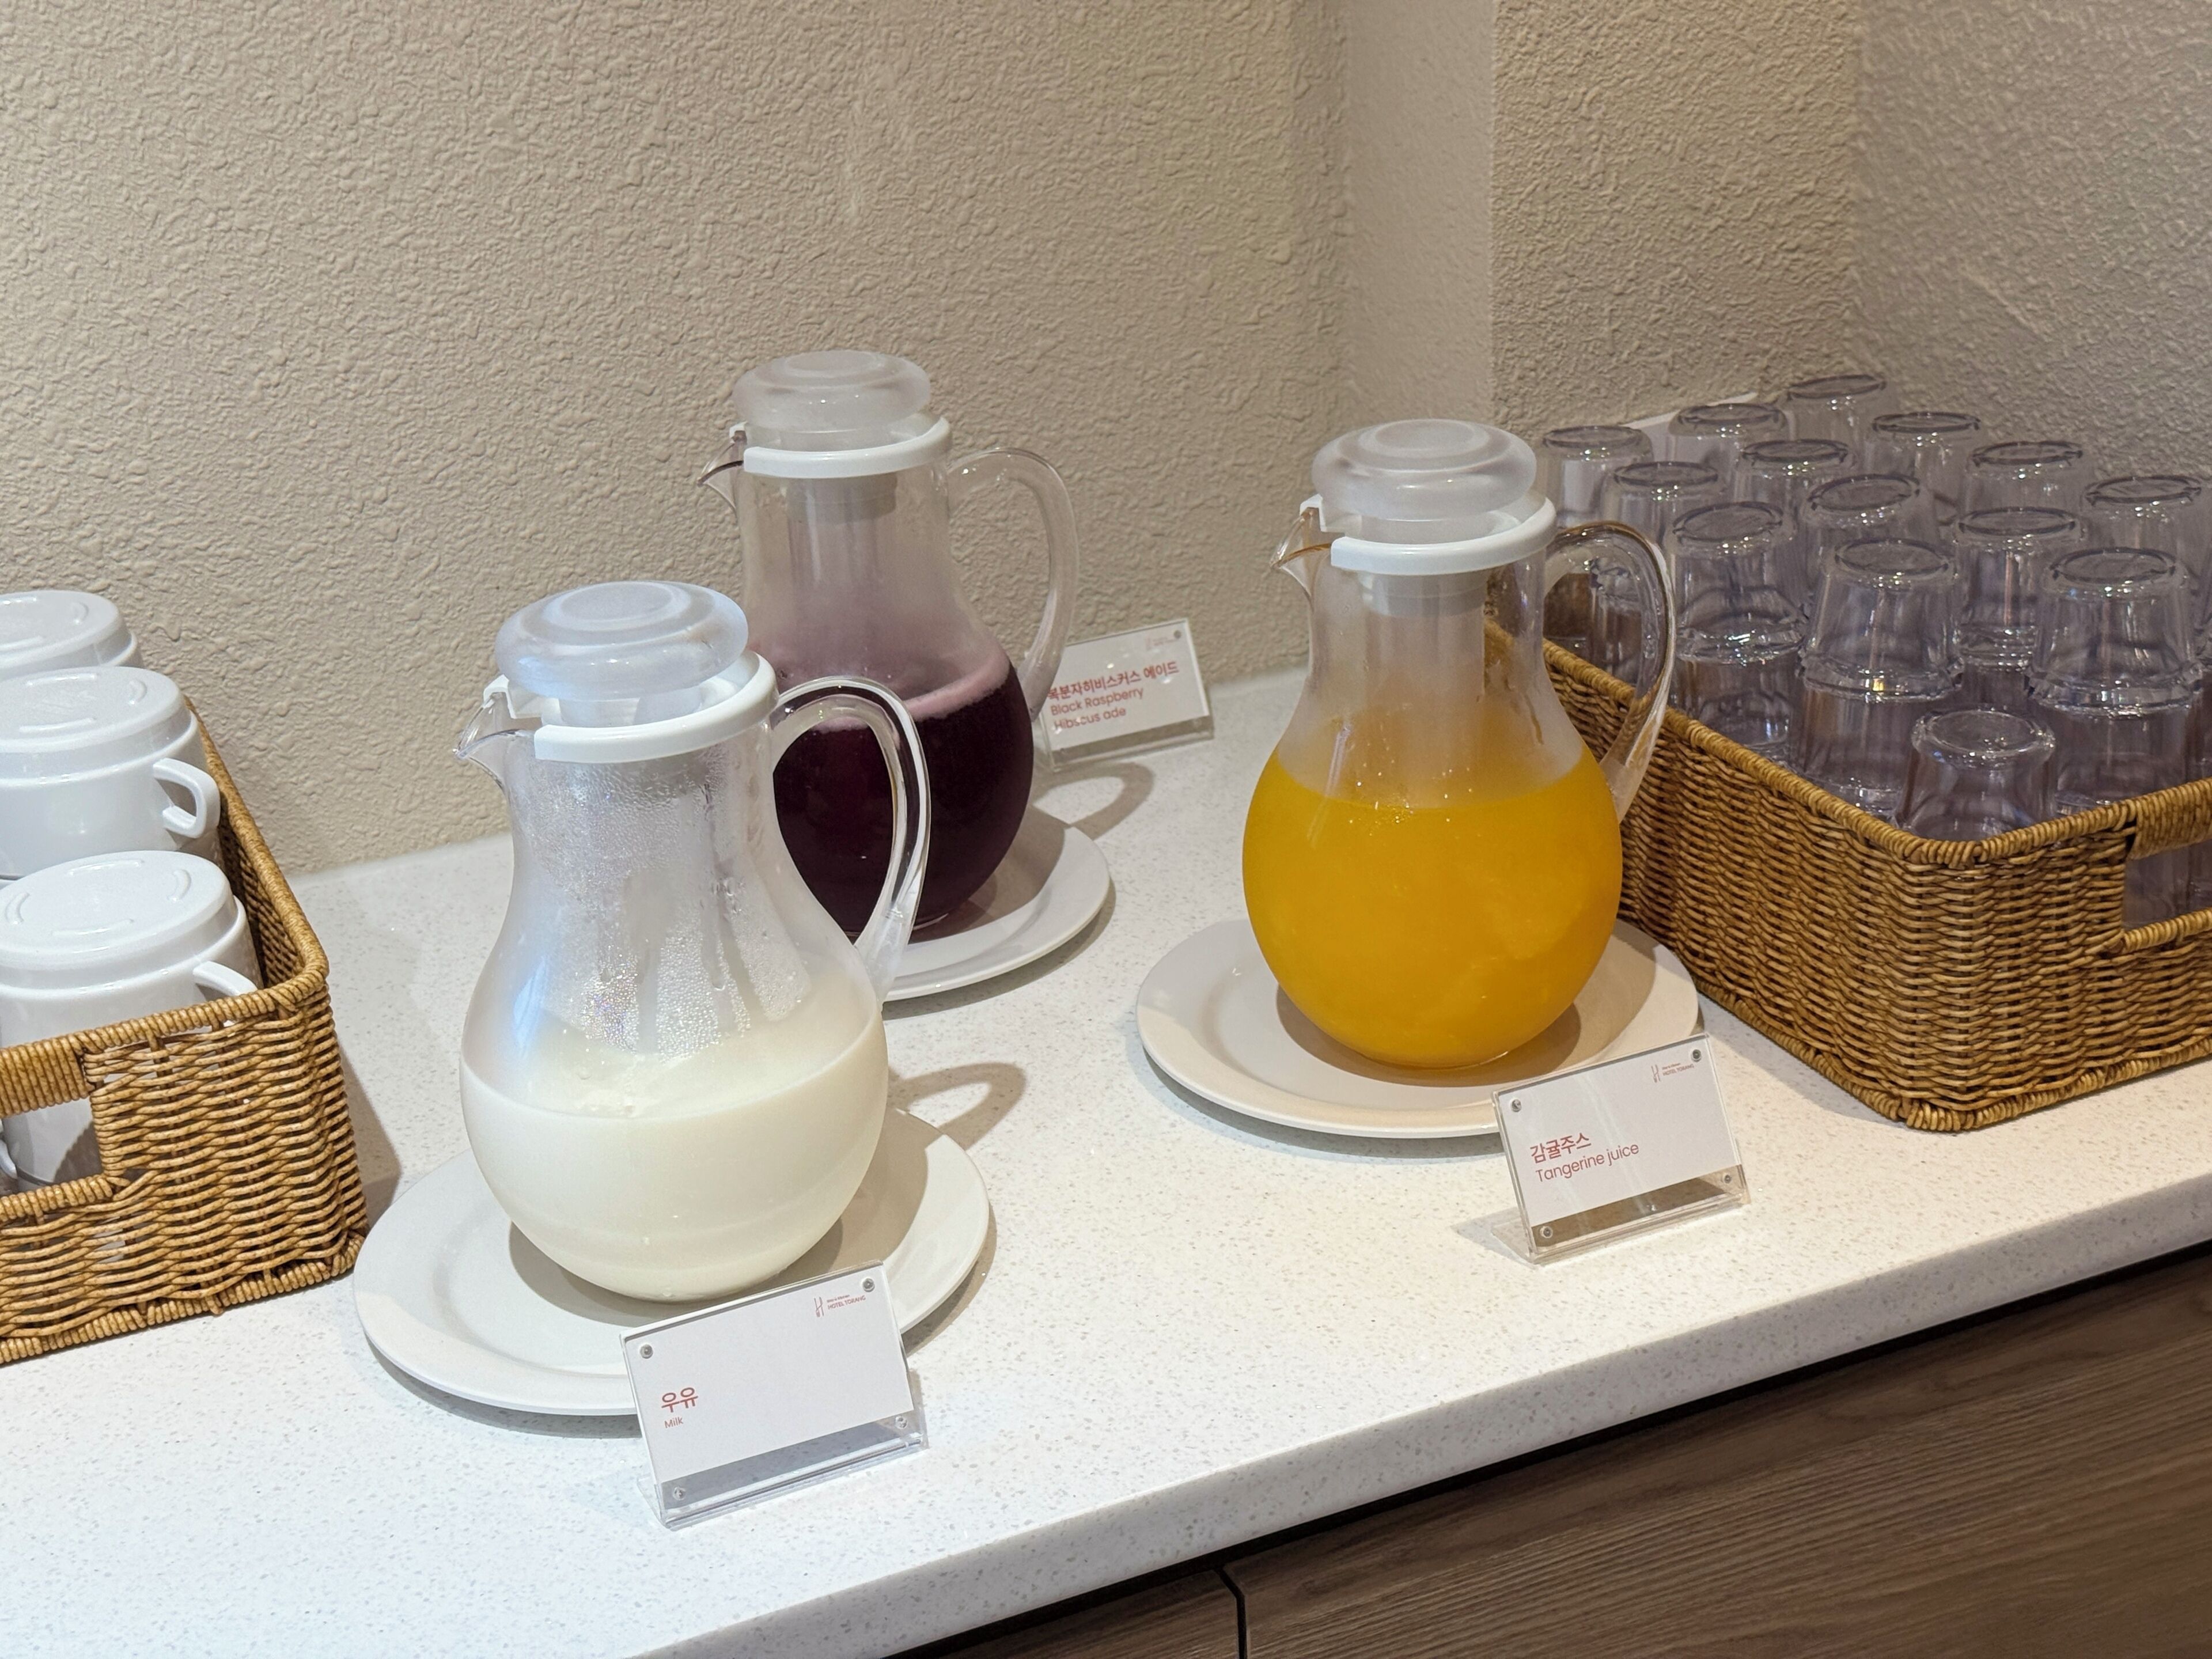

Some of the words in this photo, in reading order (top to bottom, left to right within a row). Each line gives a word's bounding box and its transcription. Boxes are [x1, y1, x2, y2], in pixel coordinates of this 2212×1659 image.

[1048, 671, 1142, 700] 복분자히비스커스
[1143, 661, 1179, 679] 에이드
[1051, 700, 1082, 715] Black
[1085, 688, 1143, 708] Raspberry
[1103, 707, 1126, 719] ade
[1530, 1132, 1592, 1164] 감귤주스
[1535, 1154, 1605, 1182] Tangerine
[1606, 1143, 1639, 1166] juice
[661, 1387, 698, 1413] 우유
[664, 1416, 684, 1429] Milk
